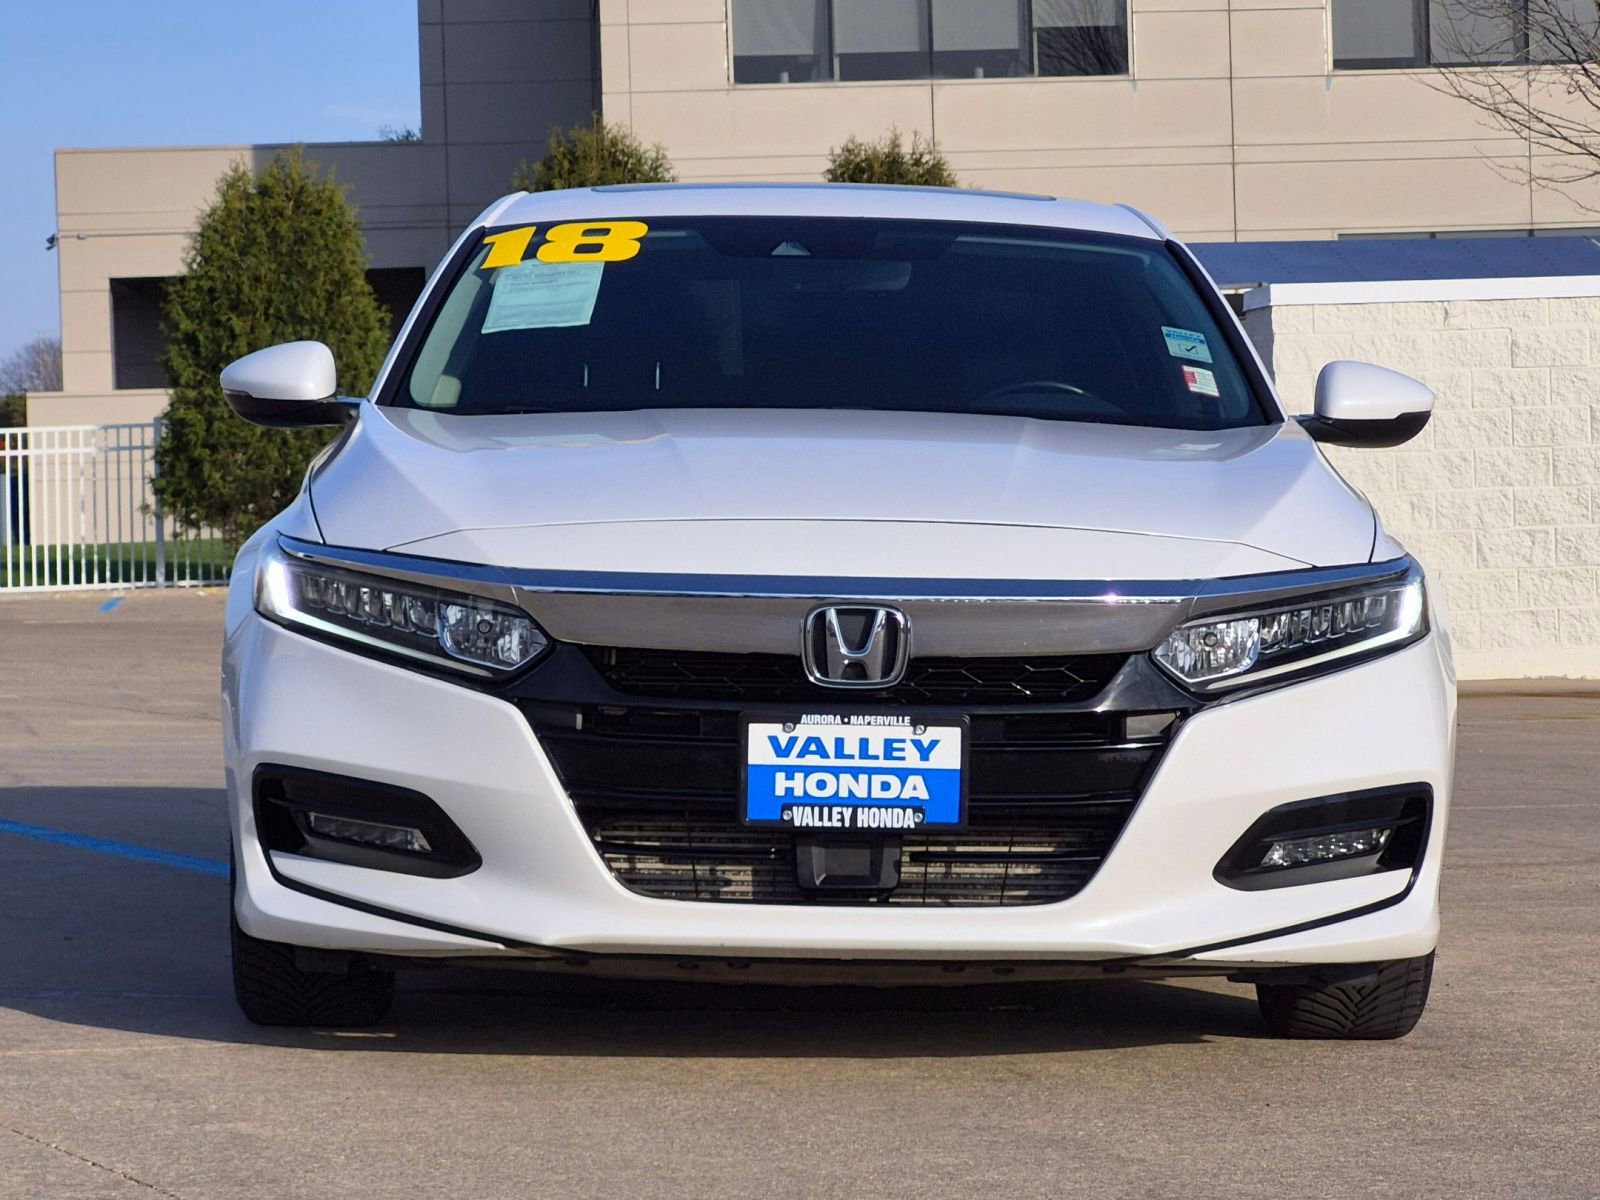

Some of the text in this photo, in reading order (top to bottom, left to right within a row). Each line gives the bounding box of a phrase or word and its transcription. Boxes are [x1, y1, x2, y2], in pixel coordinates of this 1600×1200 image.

[480, 220, 649, 269] 18
[800, 714, 911, 727] AURORA NAPERVILLE
[767, 735, 942, 762] VALLEY
[774, 771, 930, 800] HONDA
[792, 805, 915, 829] VALLEY HONDA
